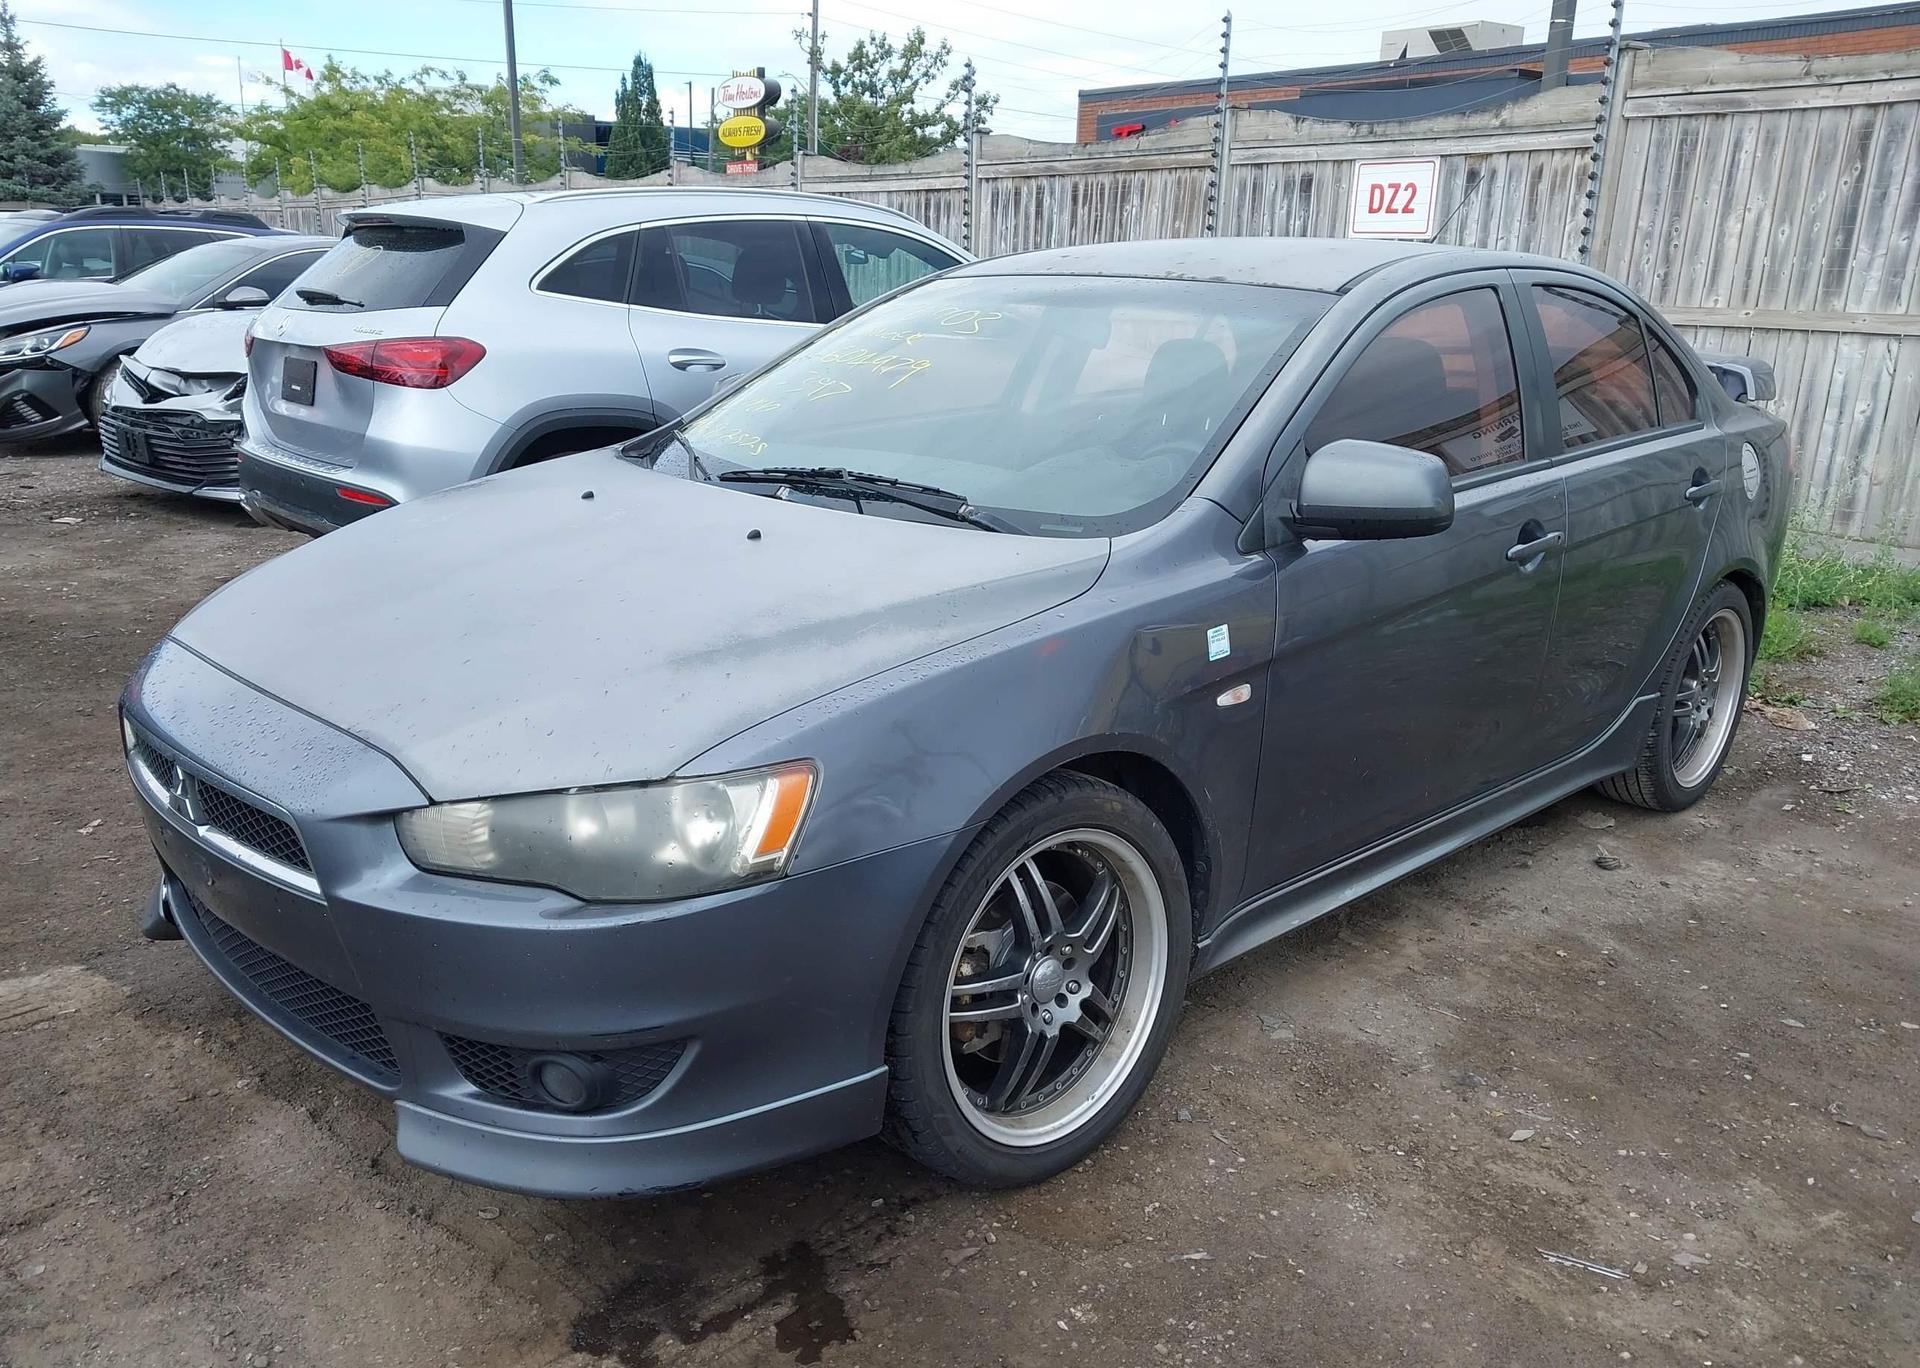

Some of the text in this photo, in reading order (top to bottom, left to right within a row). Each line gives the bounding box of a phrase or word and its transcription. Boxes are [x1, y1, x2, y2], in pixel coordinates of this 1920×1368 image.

[721, 84, 761, 103] Tim Hortons
[721, 125, 761, 138] ALWAYS FRESH
[727, 163, 758, 174] DRIVE THRU
[1368, 182, 1417, 214] DZ2
